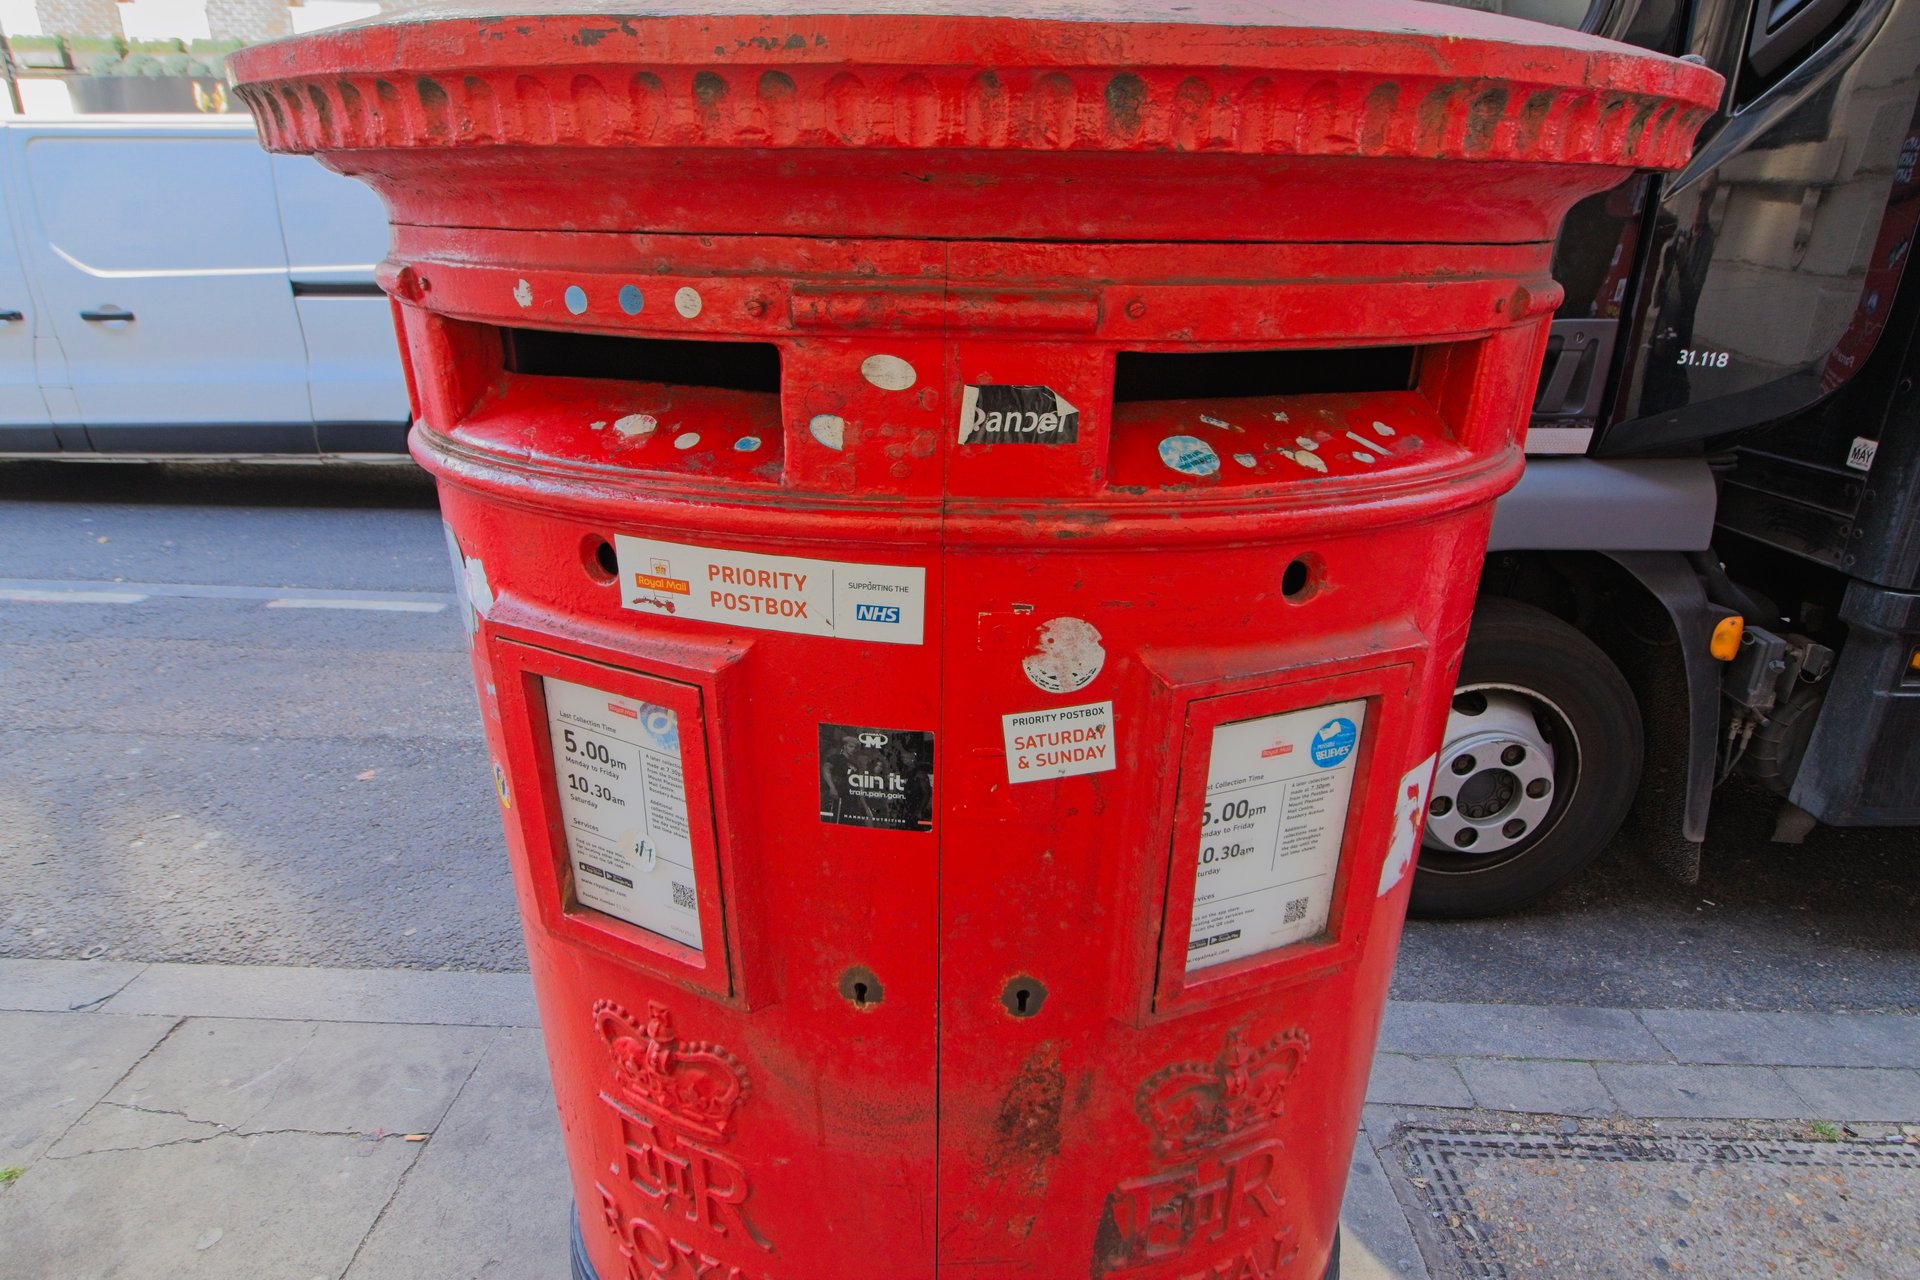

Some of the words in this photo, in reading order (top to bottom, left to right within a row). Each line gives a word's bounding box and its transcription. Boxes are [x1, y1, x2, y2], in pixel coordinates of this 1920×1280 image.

[1676, 349, 1729, 368] 31.118
[1850, 447, 1874, 463] MAY
[637, 576, 665, 590] Royal
[665, 579, 688, 591] Mail
[708, 564, 807, 591] PRIORITY
[848, 581, 894, 593] SUPPORTING
[895, 585, 909, 593] THE
[710, 591, 808, 619] POSTBOX
[858, 606, 898, 623] NHS
[559, 710, 571, 719] Last
[573, 714, 600, 728] Collection
[601, 723, 616, 733] Time
[1012, 714, 1057, 726] PRIORITY
[1060, 707, 1105, 720] POSTBOX
[1014, 724, 1106, 751] SATURDAY
[564, 729, 627, 770] 5.00pm
[1018, 756, 1029, 769] &
[1036, 744, 1106, 767] SUNDAY
[565, 755, 589, 770] Monday
[590, 764, 597, 772] to
[599, 766, 619, 780] Friday
[568, 773, 625, 806] 10.30am
[889, 772, 905, 791] it
[1214, 777, 1246, 789] Collection
[1248, 772, 1264, 782] Time
[570, 793, 597, 809] Saturday
[849, 789, 906, 800] train.pain.gain.
[573, 818, 599, 832] Services
[1200, 828, 1221, 840] onday
[1232, 821, 1255, 833] Friday
[1198, 844, 1254, 866] 0.30am
[1197, 867, 1220, 878] turday
[1194, 893, 1215, 903] rvices
